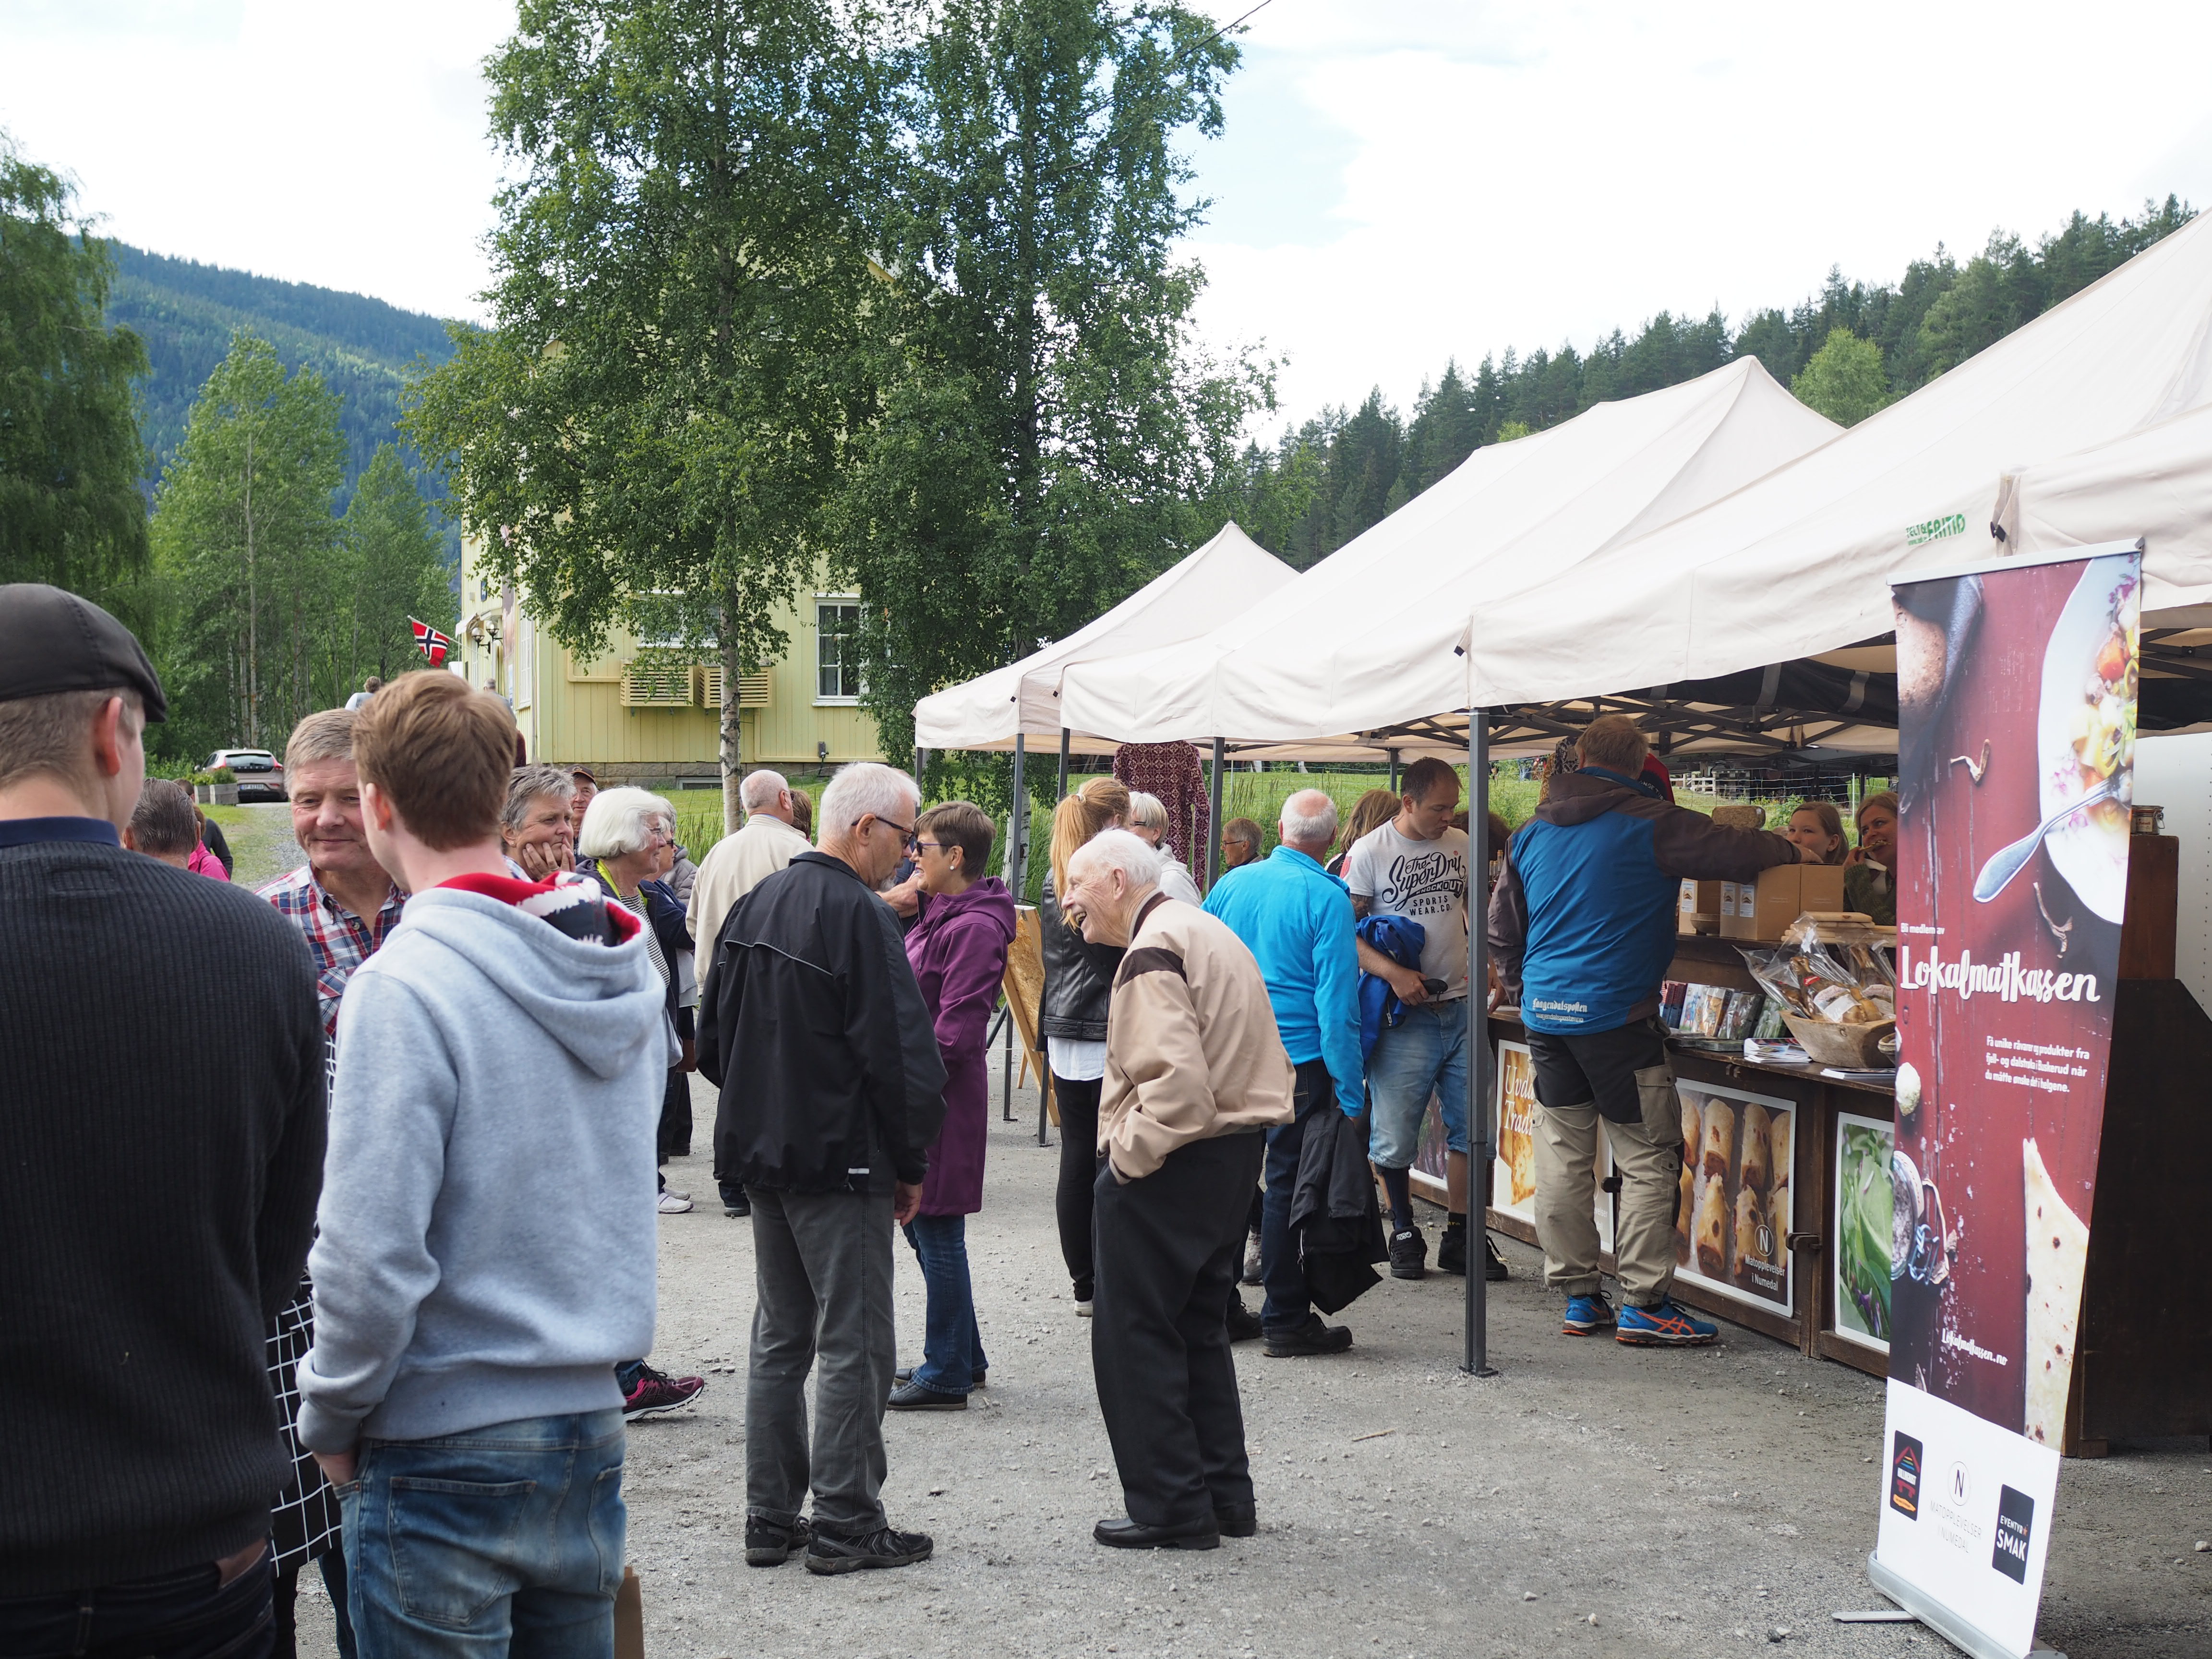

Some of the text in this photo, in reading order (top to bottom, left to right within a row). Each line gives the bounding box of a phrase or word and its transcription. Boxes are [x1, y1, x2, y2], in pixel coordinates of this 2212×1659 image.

[1405, 853, 1431, 874] The
[1416, 879, 1463, 896] KNOCKOUT
[1413, 895, 1448, 907] SPORTS
[1900, 922, 1945, 935] Bli medlem av
[1900, 945, 2101, 1003] Lokalmatkassen
[1986, 1035, 1994, 1047] Få
[1994, 1038, 2012, 1049] unike
[2033, 1045, 2039, 1056] og
[2039, 1044, 2075, 1058] produkter
[2076, 1047, 2090, 1060] fra
[1985, 1052, 2000, 1066] fjell-
[2000, 1057, 2009, 1069] og
[2038, 1059, 2069, 1075] Buskerud
[2071, 1066, 2088, 1077] når
[1985, 1069, 1993, 1080] du
[1993, 1071, 2012, 1083] måtte
[2013, 1074, 2030, 1086] ønske
[2040, 1079, 2070, 1093] helgene.
[1760, 1228, 1768, 1253] N
[1745, 1254, 1785, 1277] Matopplevelser
[1752, 1273, 1778, 1291] i Numedal
[1941, 1327, 2008, 1366] Lokalmatkassen.no
[1954, 1469, 1964, 1498] N
[1930, 1500, 1982, 1540] MATOPPLEVELSER
[2000, 1515, 2023, 1535] EVENTYR
[1941, 1526, 1969, 1553] NUMEDAL
[1996, 1528, 2027, 1562] SMAK
